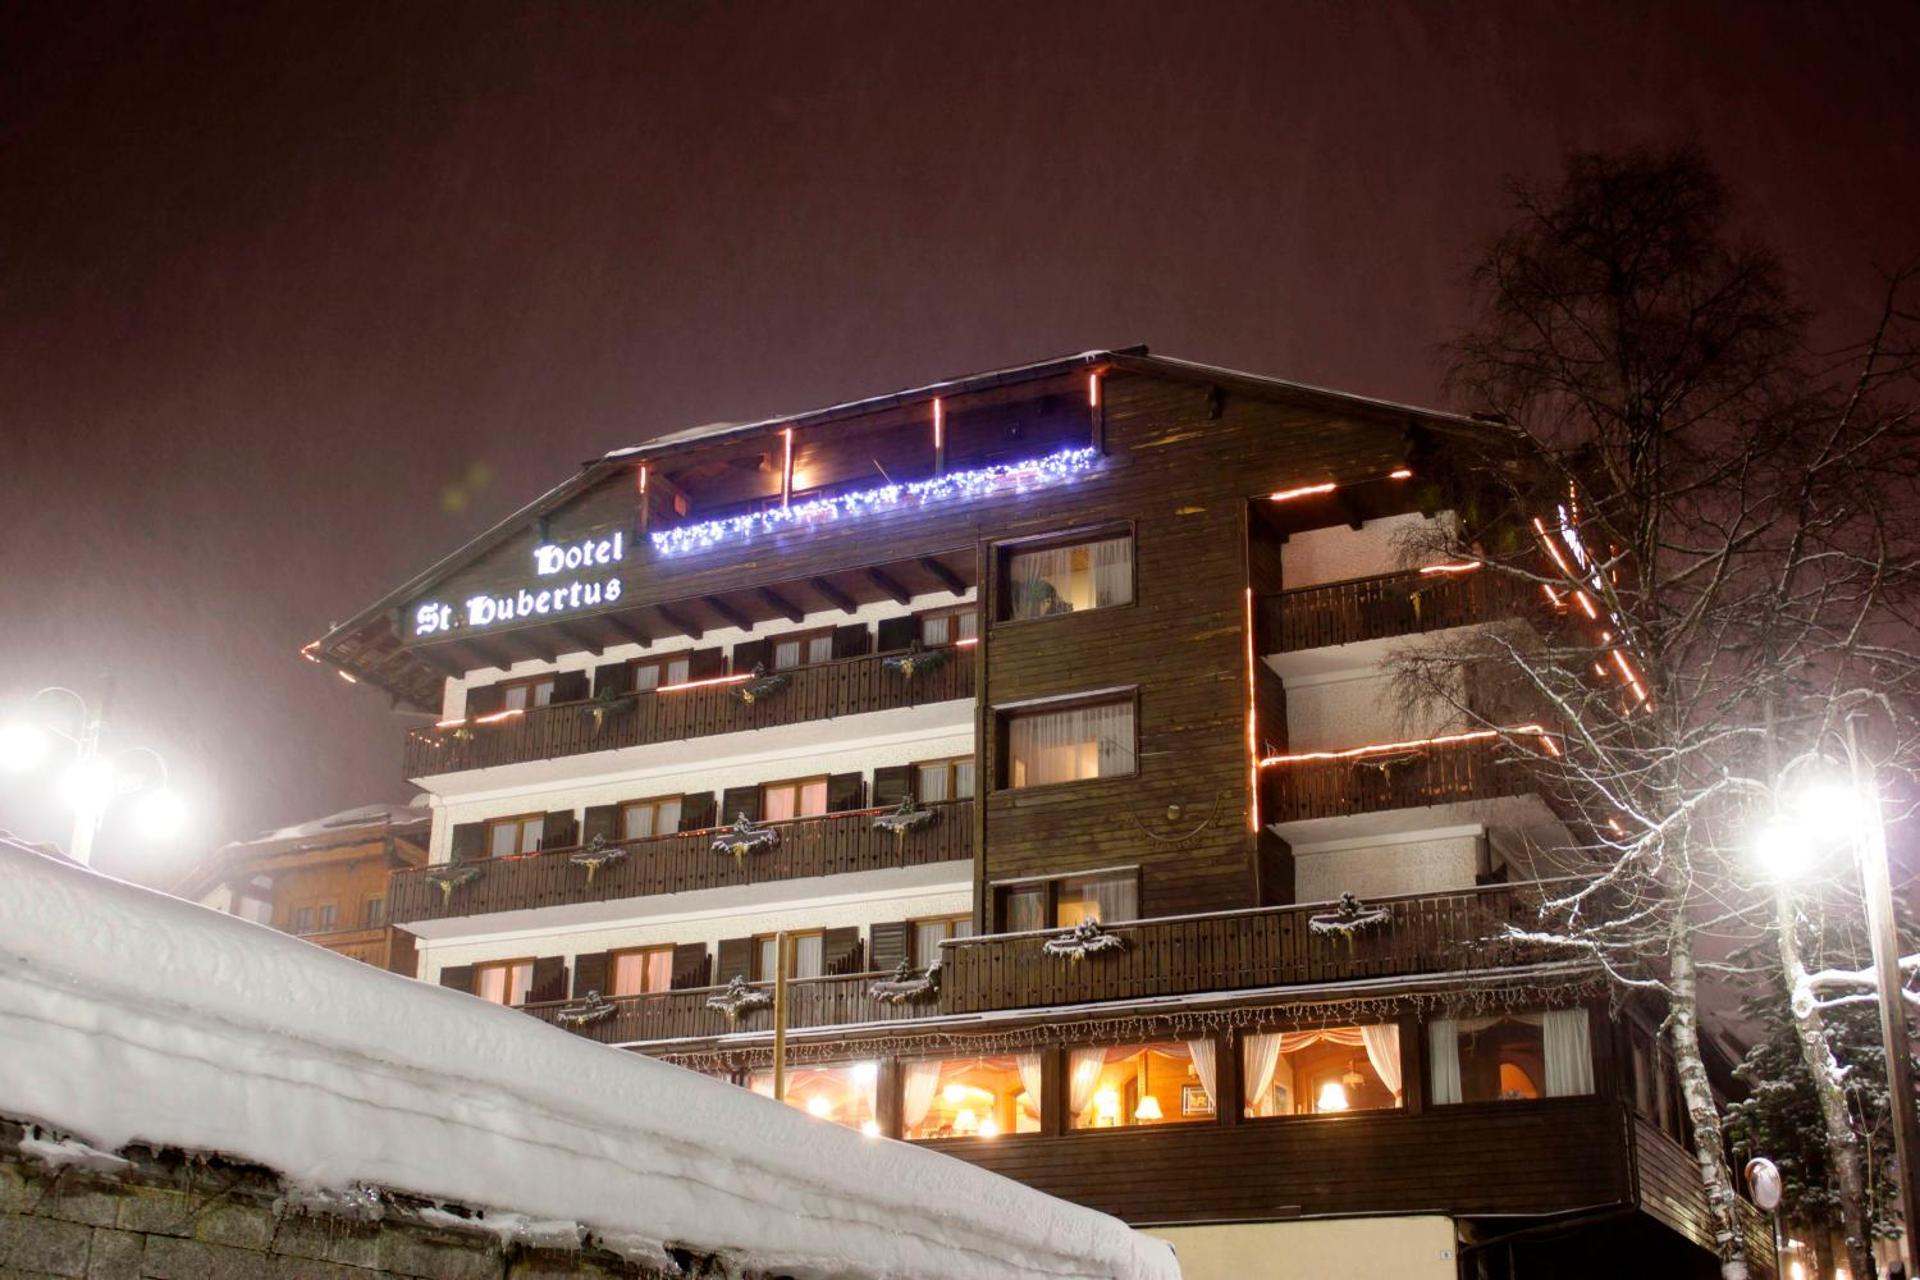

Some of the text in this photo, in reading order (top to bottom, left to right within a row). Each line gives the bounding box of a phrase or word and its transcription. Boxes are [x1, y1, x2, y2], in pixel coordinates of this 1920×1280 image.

[533, 531, 623, 576] Hotel
[415, 577, 622, 636] St. Hubertus
